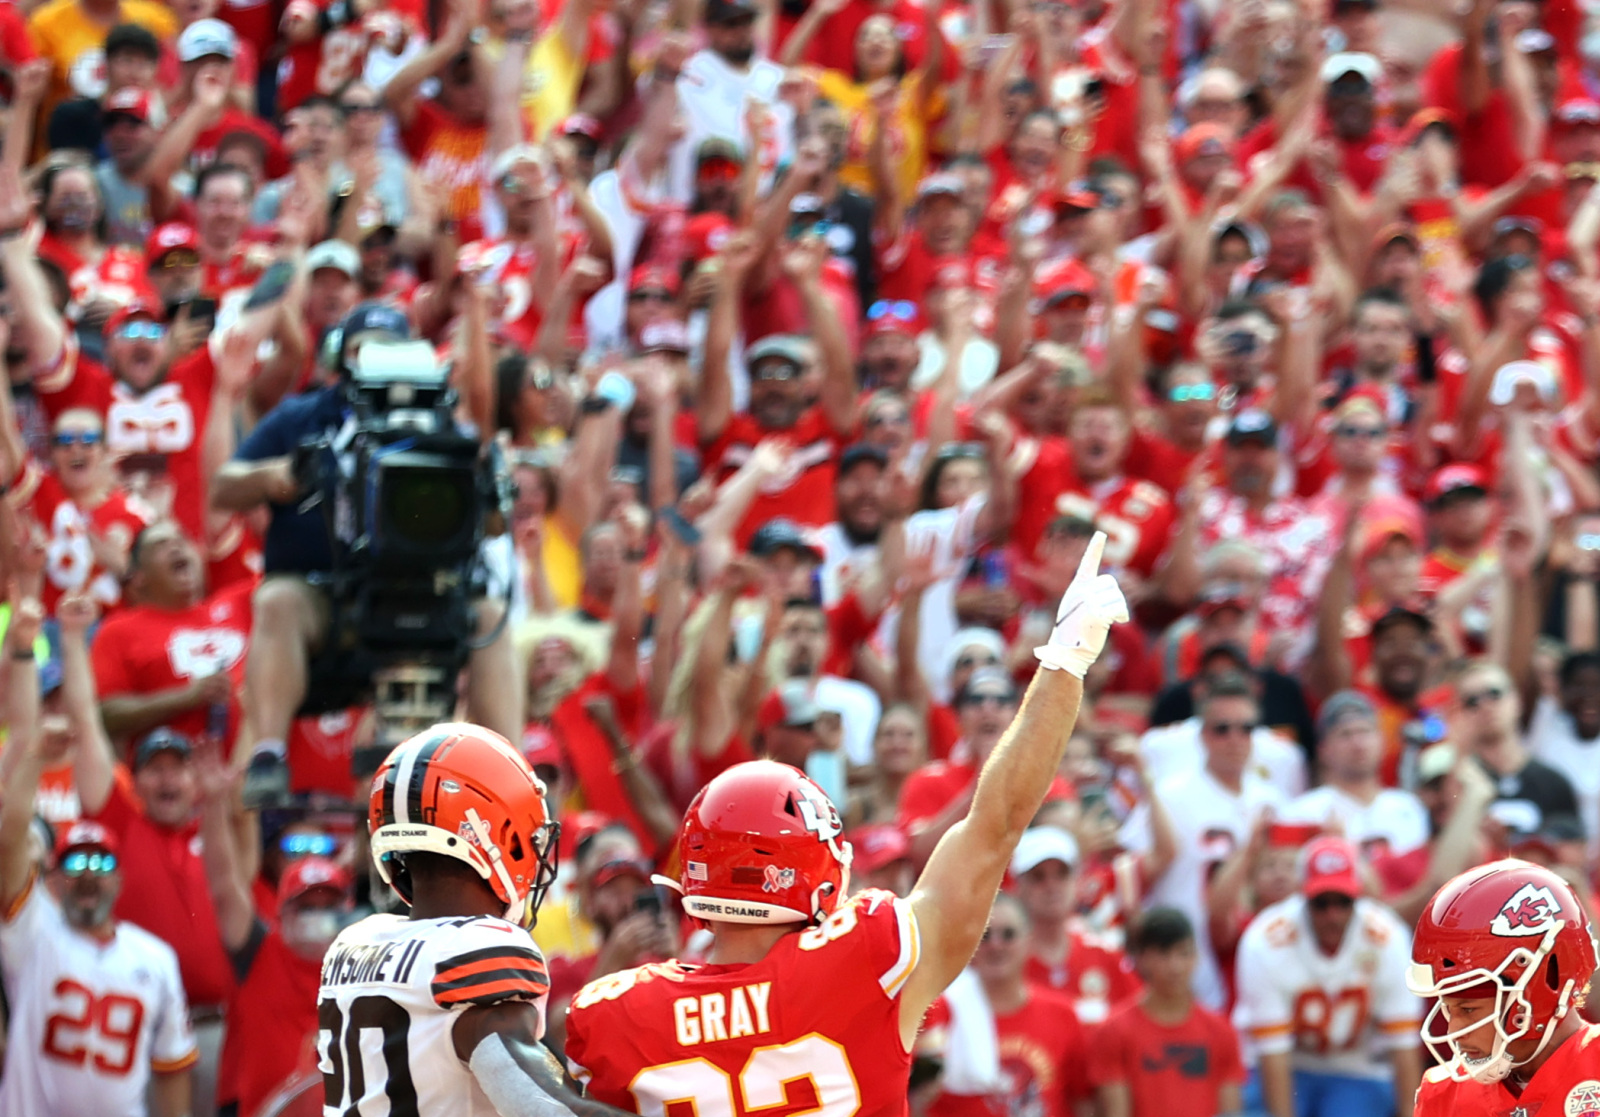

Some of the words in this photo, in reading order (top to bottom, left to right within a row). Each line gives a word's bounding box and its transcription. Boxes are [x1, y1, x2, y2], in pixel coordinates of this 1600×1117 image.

[724, 905, 770, 918] CHANGE
[1501, 896, 1554, 931] KC
[43, 978, 144, 1078] 29
[673, 981, 772, 1046] GRAY
[1293, 982, 1373, 1056] 87
